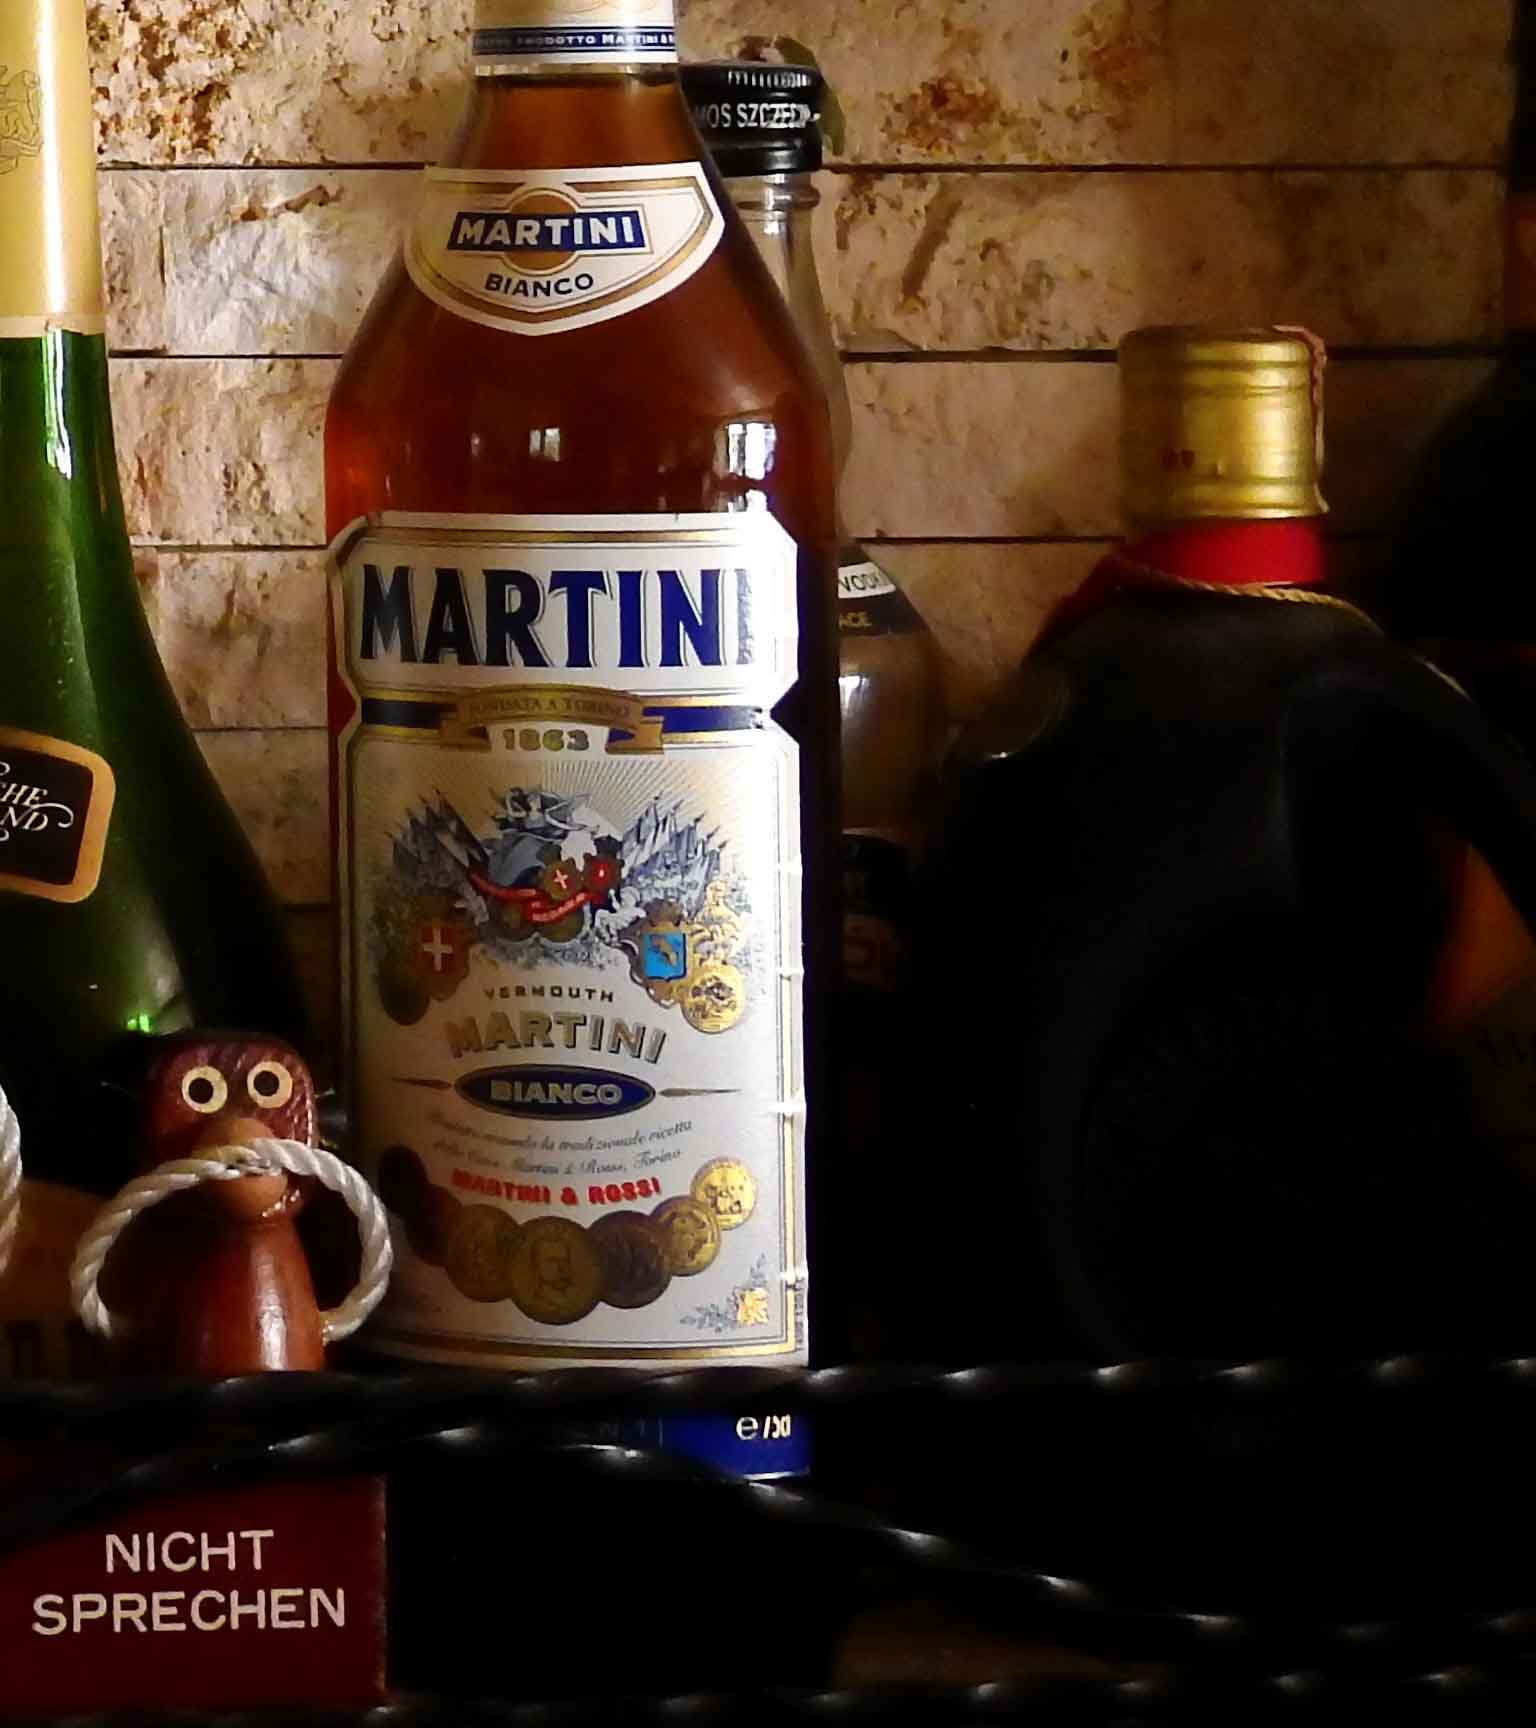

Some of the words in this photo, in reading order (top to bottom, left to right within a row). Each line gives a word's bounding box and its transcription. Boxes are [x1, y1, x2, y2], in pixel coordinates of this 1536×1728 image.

[457, 215, 637, 246] MARTINI
[485, 272, 595, 298] BIANCO
[359, 564, 758, 668] MARTINI
[483, 986, 615, 1003] VERMOUTH
[444, 1011, 667, 1065] MARTINI
[489, 1078, 623, 1106] BIANCO
[588, 1176, 661, 1206] ROSSI
[104, 1528, 274, 1575] NICHT
[31, 1586, 346, 1637] SPRECHEN
